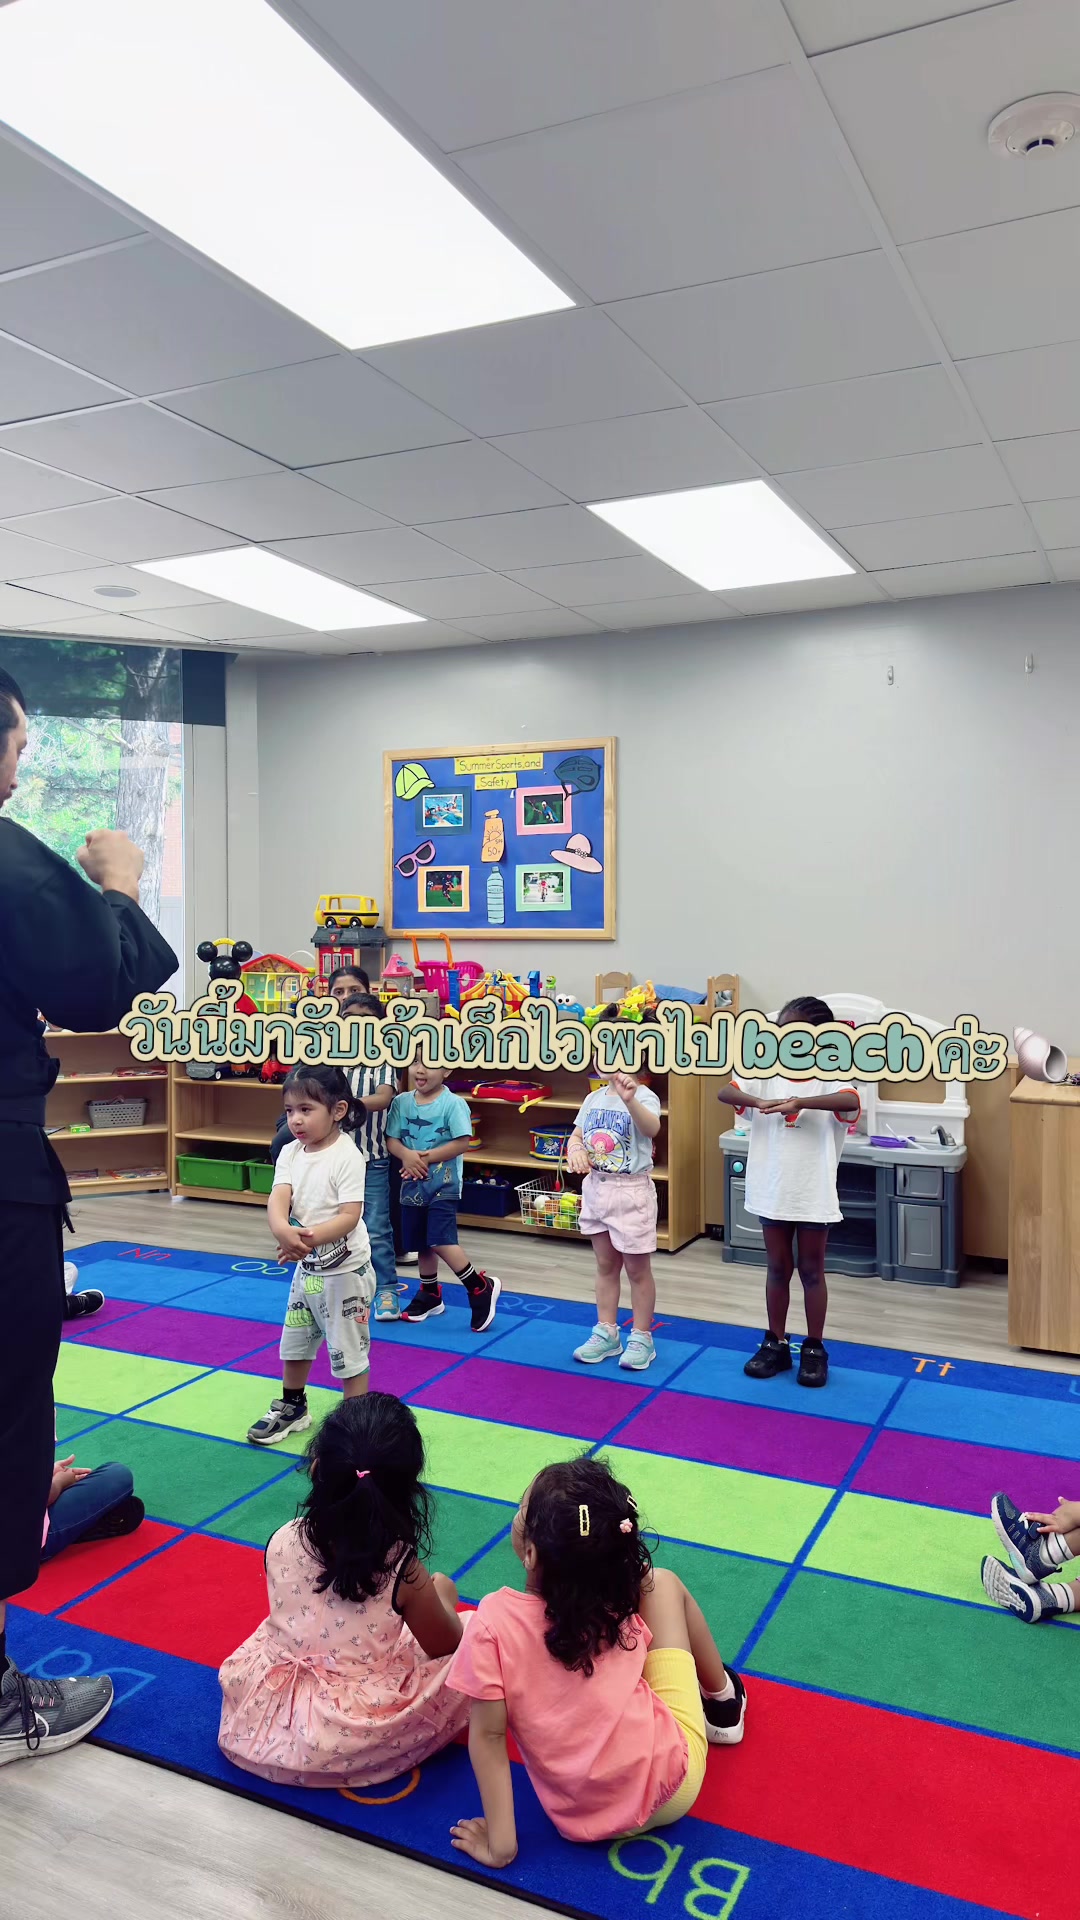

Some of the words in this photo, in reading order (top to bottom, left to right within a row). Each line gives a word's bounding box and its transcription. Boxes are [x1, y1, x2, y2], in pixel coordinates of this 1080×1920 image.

[459, 760, 494, 772] Summer
[525, 756, 541, 768] and
[480, 776, 509, 788] Safety
[911, 1356, 956, 1377] Tt
